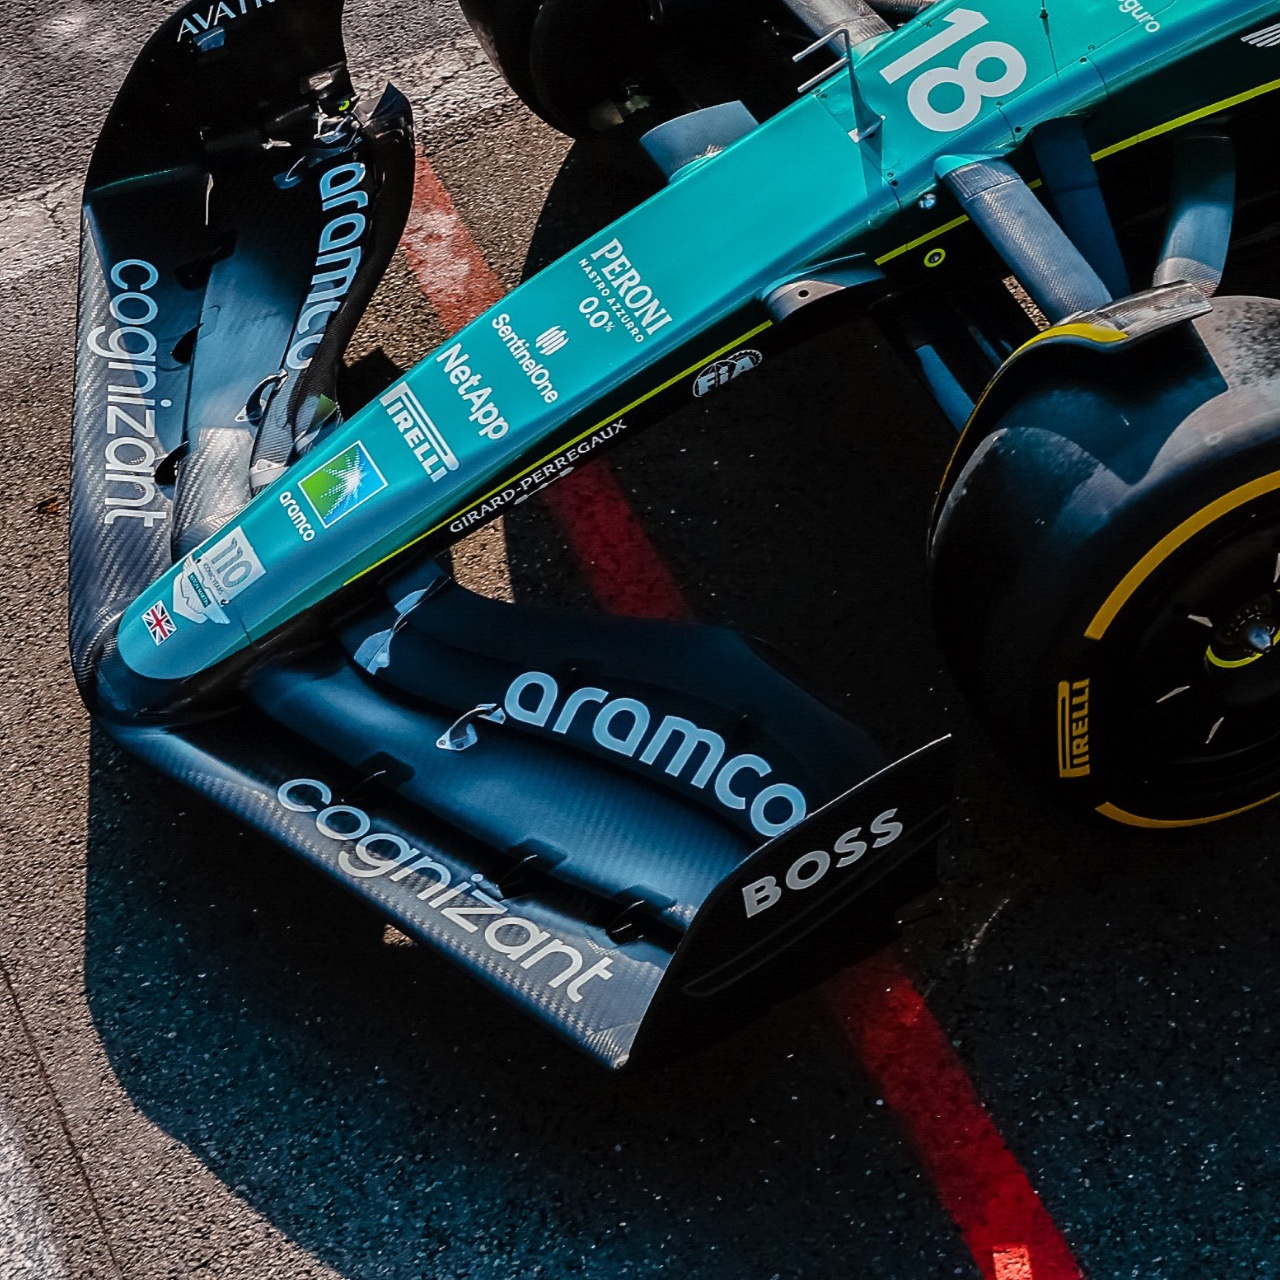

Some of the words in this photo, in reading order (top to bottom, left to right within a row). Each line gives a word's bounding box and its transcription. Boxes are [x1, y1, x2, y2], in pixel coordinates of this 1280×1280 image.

[879, 8, 1027, 132] 18
[286, 163, 368, 370] aramco
[579, 258, 609, 296] NASTRO
[606, 297, 644, 342] AZZURRO
[579, 296, 615, 333] 0.0%
[590, 238, 673, 335] PERONI
[87, 259, 172, 527] cognizant
[436, 343, 509, 440] NetApp
[491, 313, 558, 404] SentinelOne
[379, 381, 459, 483] PIRELLI
[450, 419, 627, 533] GIRARD-PERREGAUX
[211, 537, 252, 588] 110
[279, 491, 315, 542] aramco
[504, 671, 806, 836] aramco
[1058, 678, 1090, 778] PIRELLI
[276, 778, 613, 1003] cognizant
[742, 808, 902, 918] BOSS
